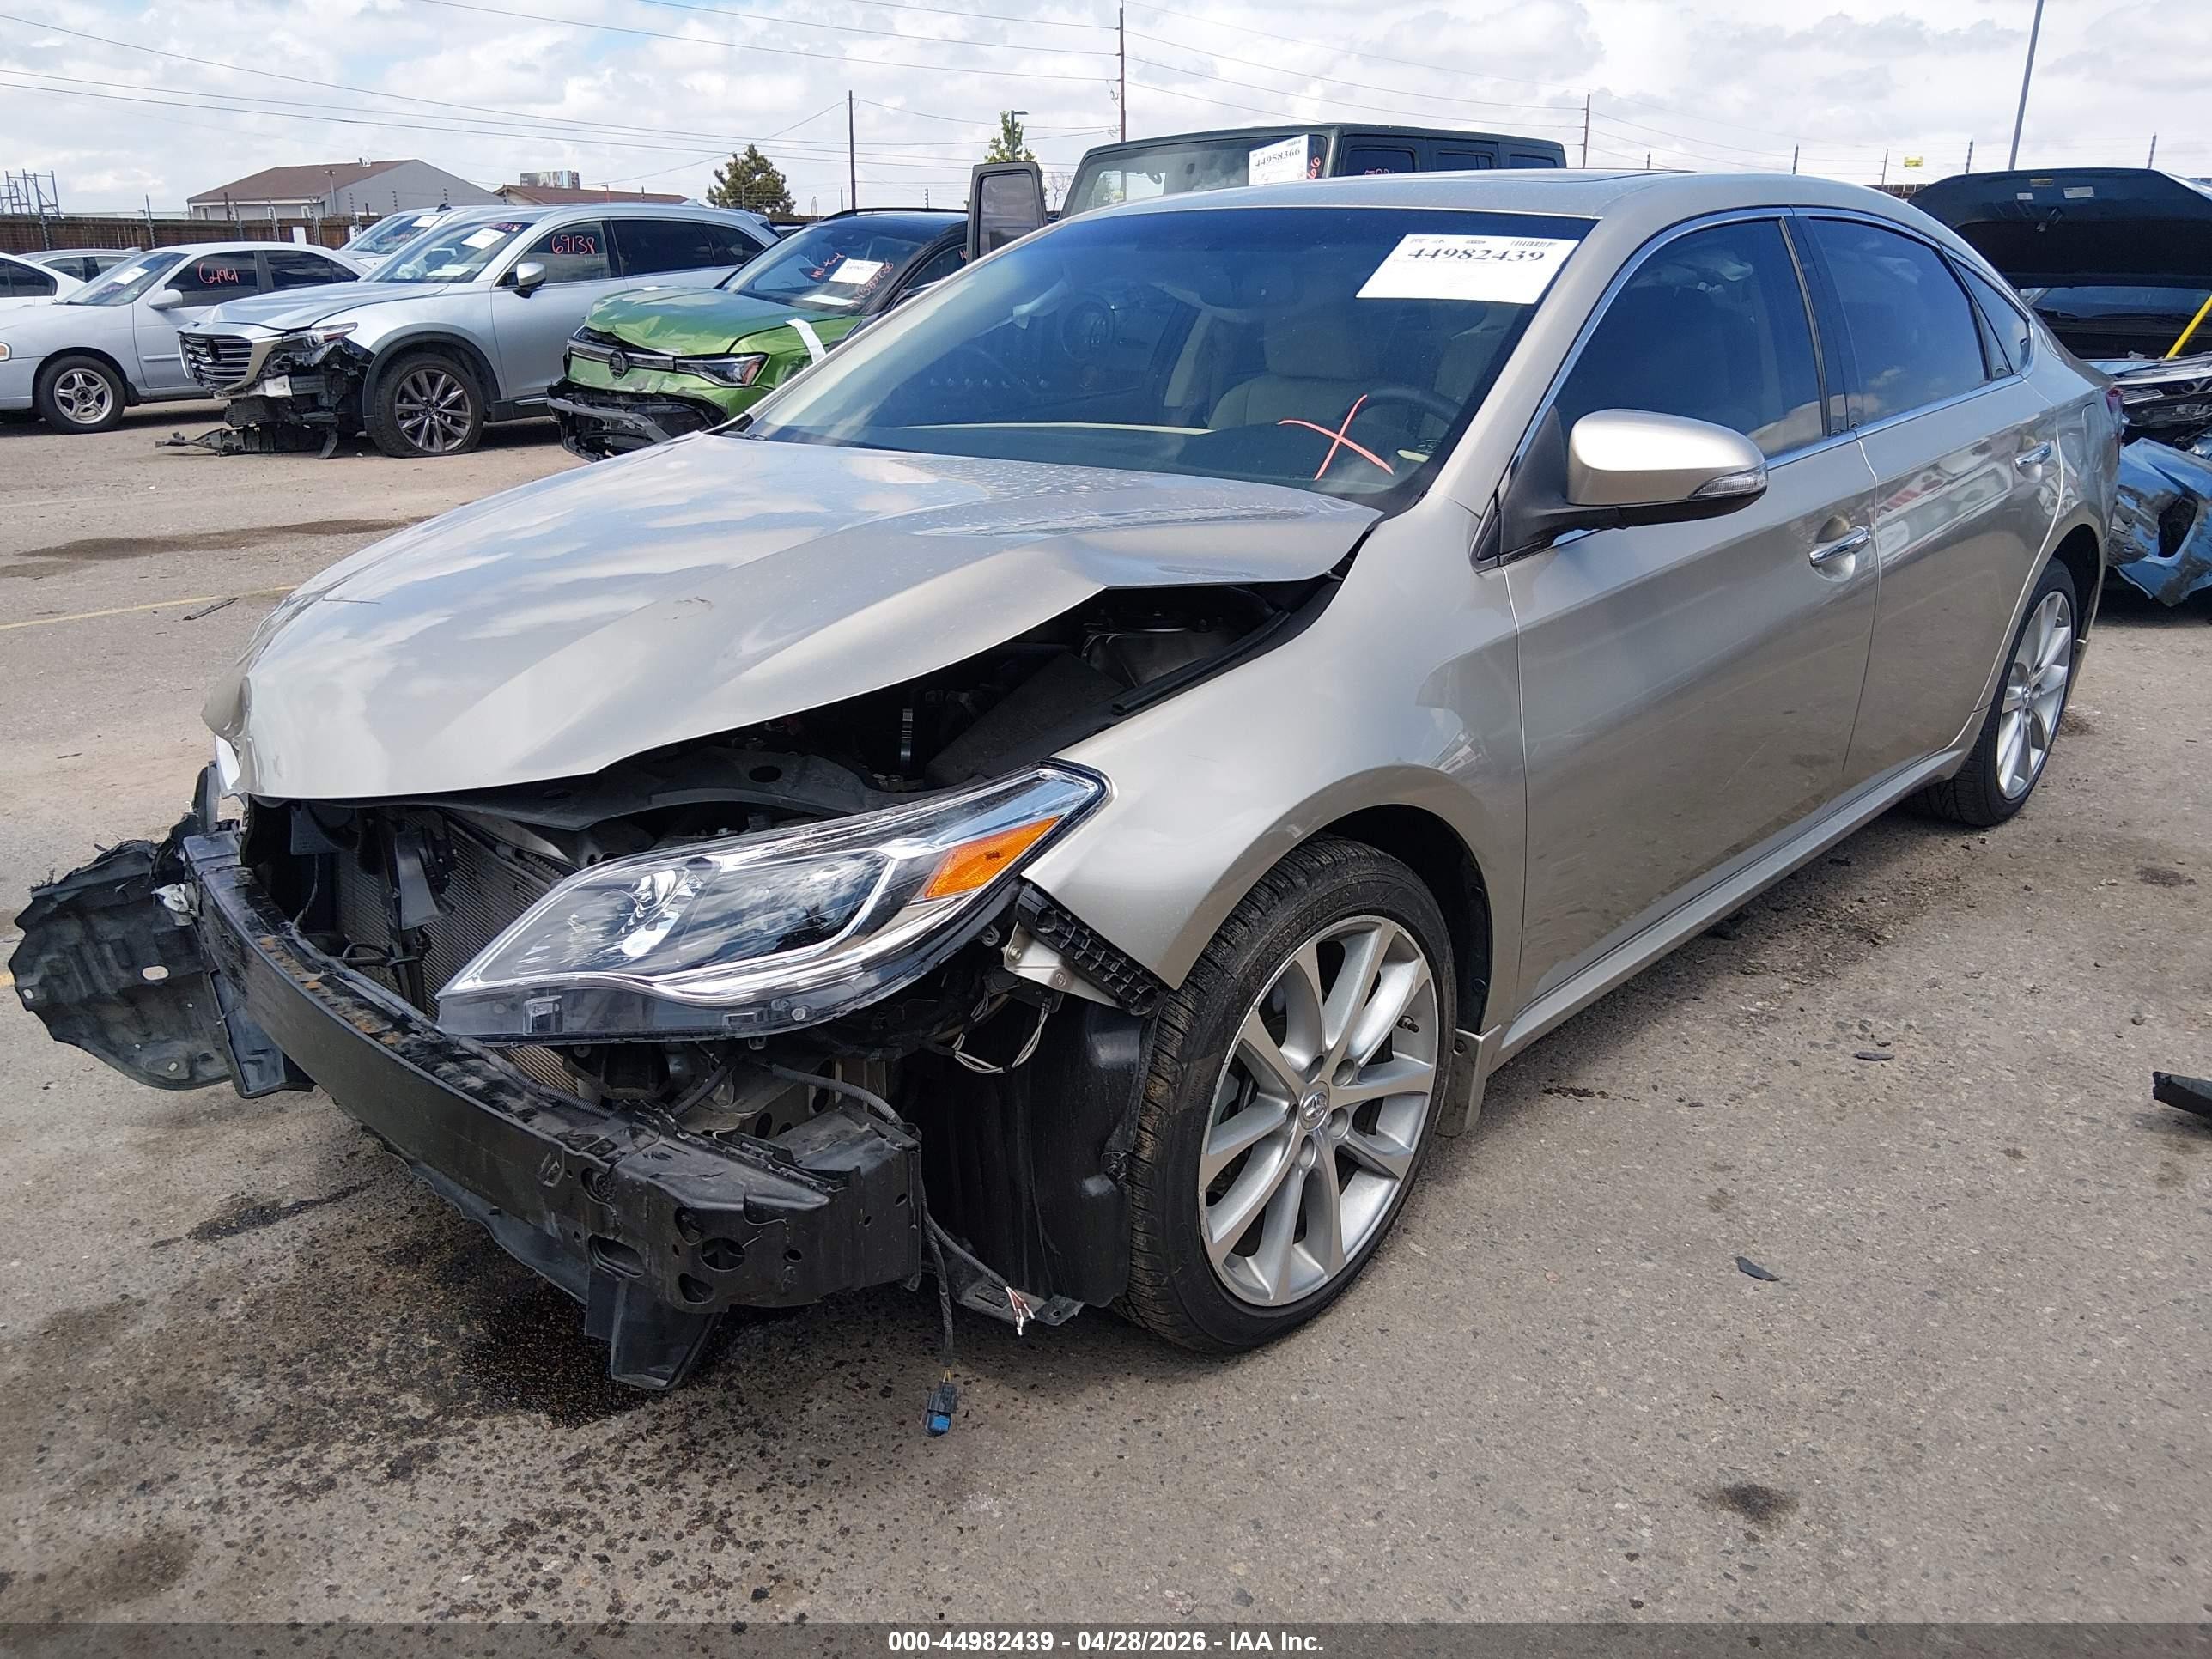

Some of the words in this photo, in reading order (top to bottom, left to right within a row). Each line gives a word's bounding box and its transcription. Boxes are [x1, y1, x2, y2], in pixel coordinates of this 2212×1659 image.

[1255, 147, 1301, 167] 44958366
[551, 234, 596, 255] 69138
[1407, 247, 1546, 262] 44982439
